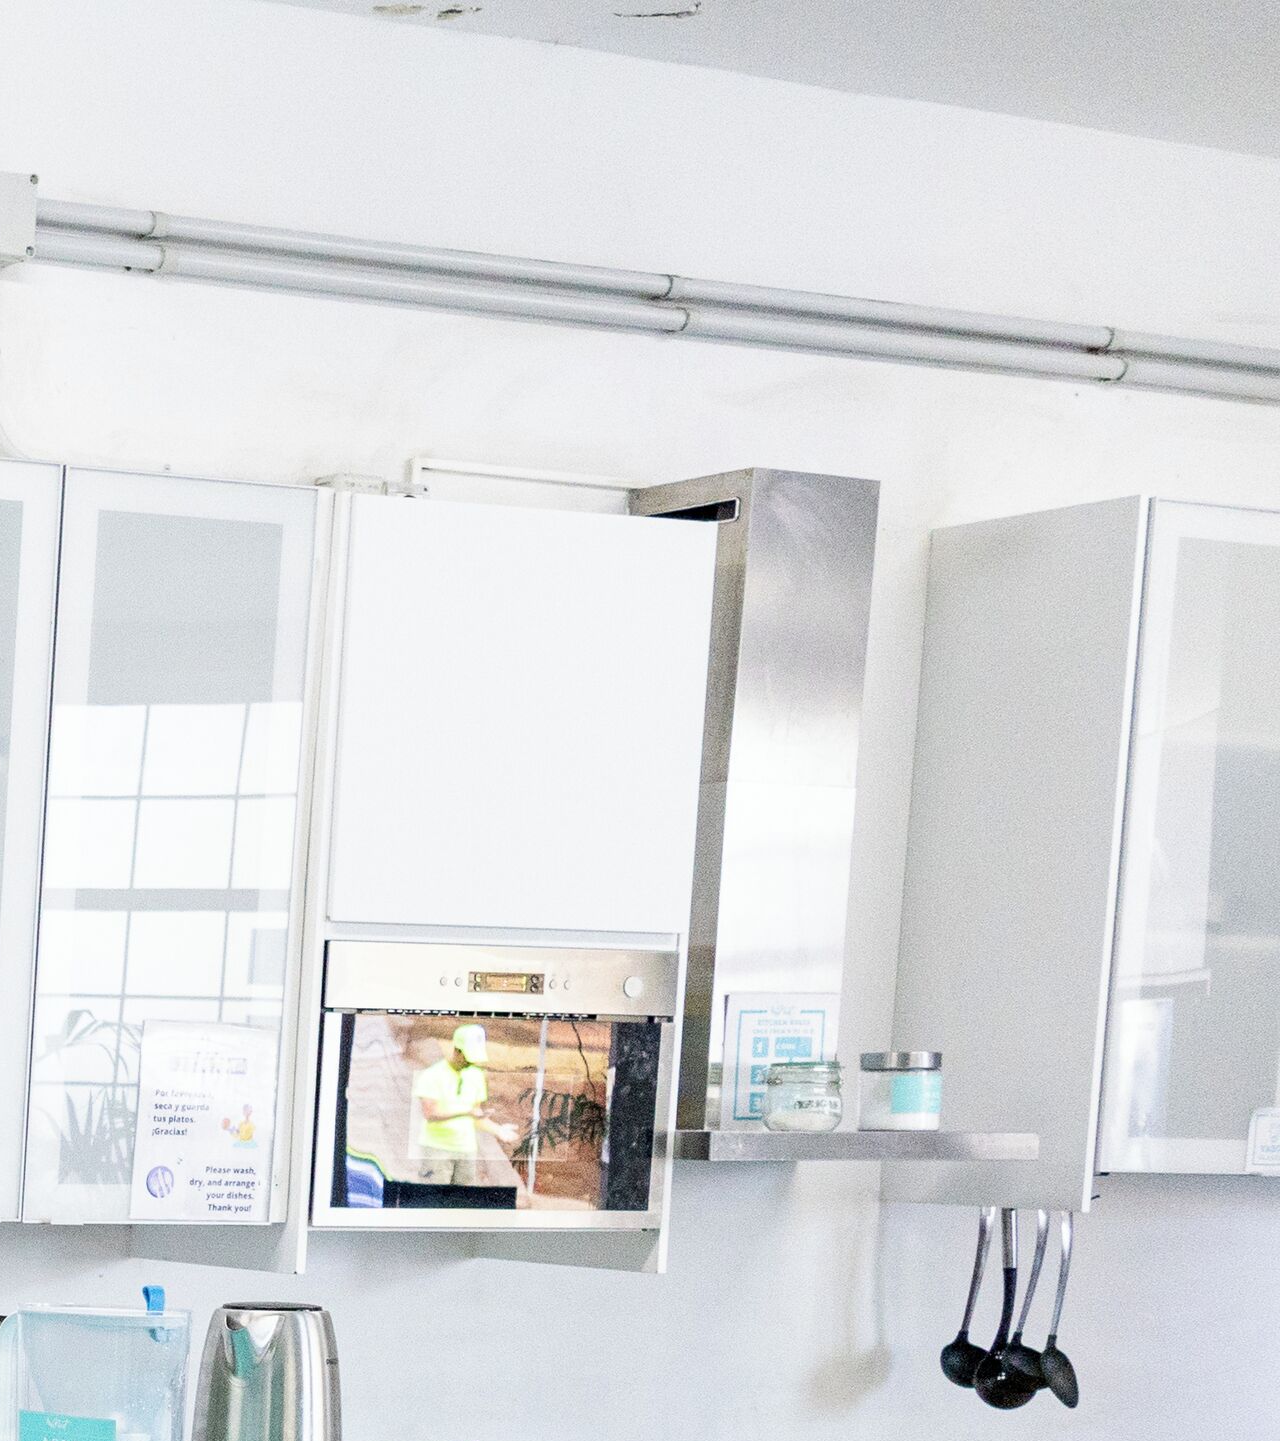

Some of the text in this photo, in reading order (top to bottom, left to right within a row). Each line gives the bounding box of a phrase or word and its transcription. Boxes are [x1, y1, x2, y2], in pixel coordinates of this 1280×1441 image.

[152, 1127, 188, 1137] ¡Gracias!
[205, 1166, 256, 1175] Please wash,
[189, 1179, 256, 1189] dry, and arrange
[226, 1191, 254, 1199] dishes.
[207, 1203, 252, 1213] Thank you!
